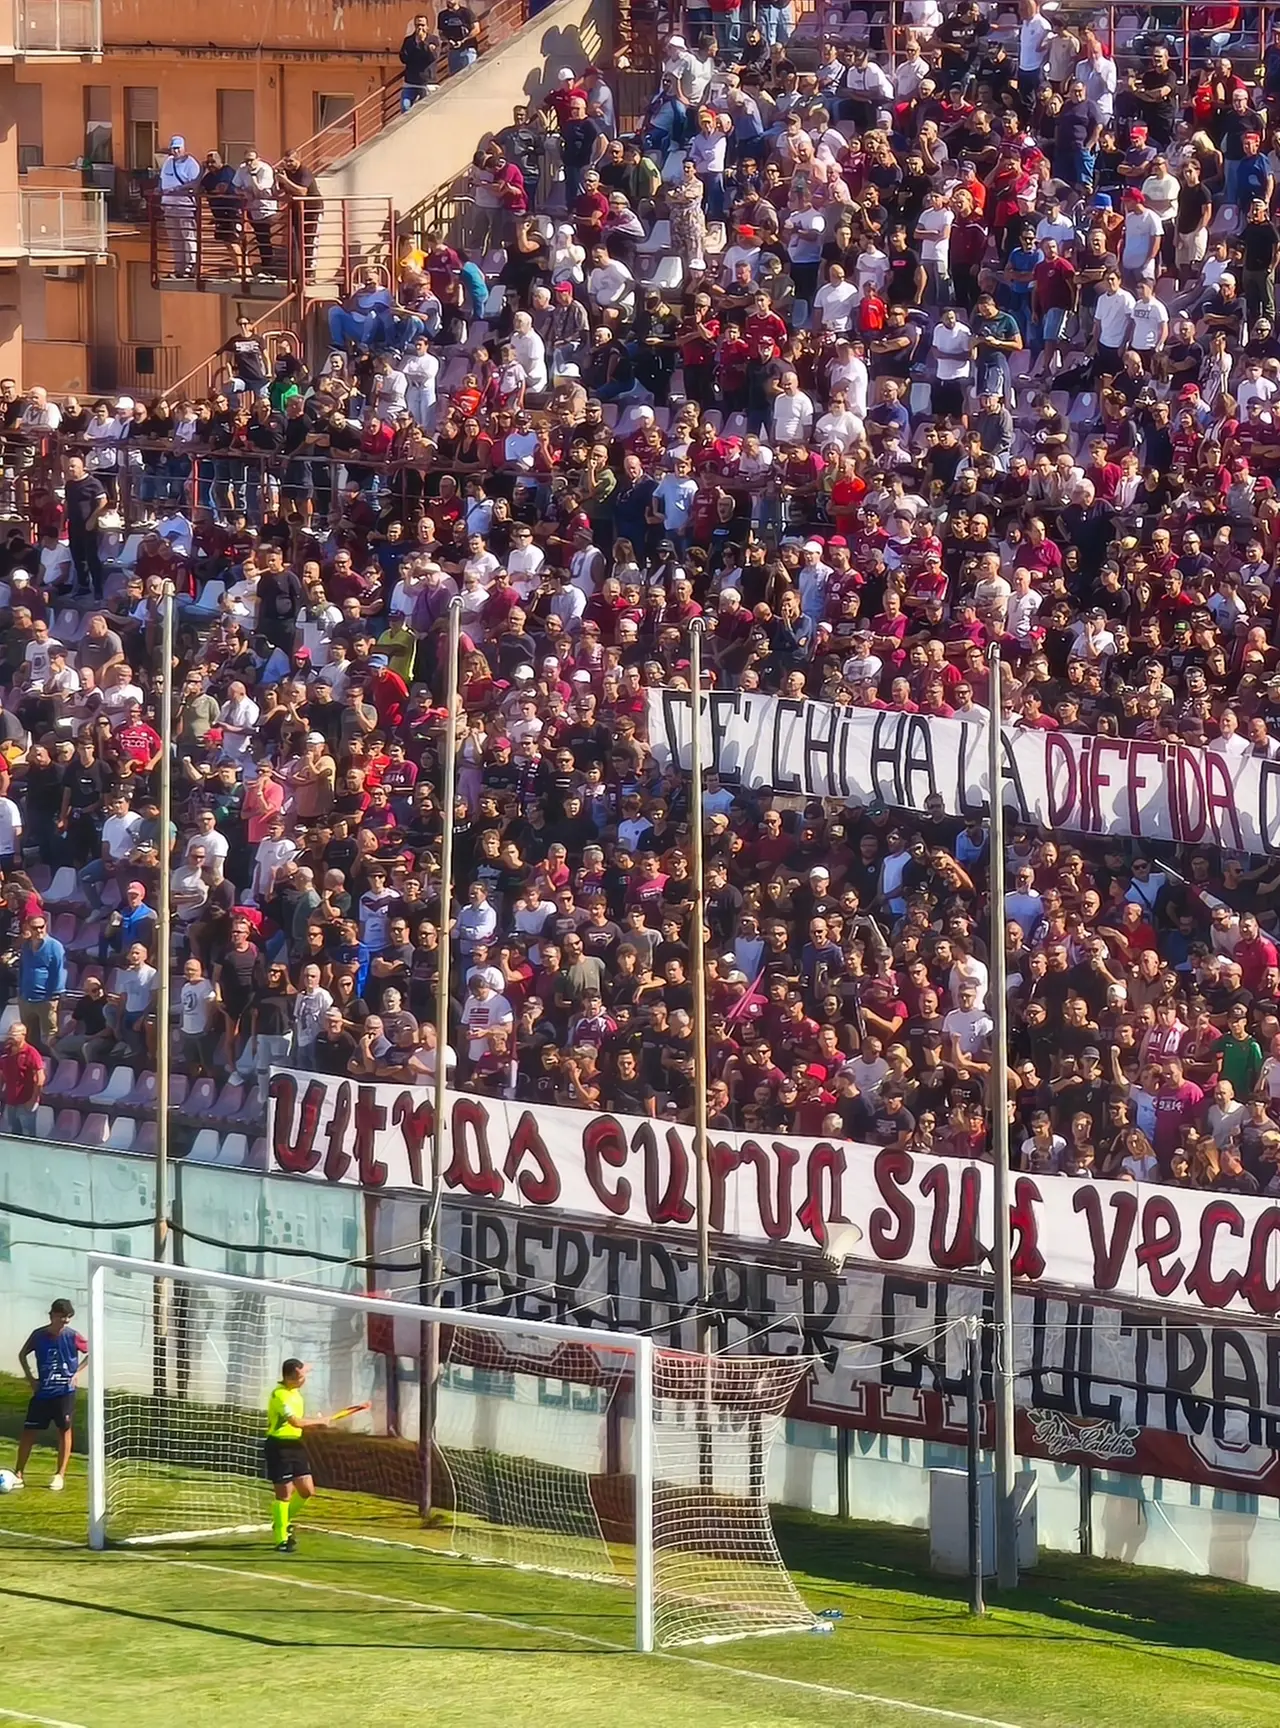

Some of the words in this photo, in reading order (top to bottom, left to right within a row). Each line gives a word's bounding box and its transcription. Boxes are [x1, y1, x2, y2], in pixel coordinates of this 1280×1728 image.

[870, 712, 938, 812] HA
[956, 720, 1032, 824] LA
[713, 1254, 840, 1374] PER
